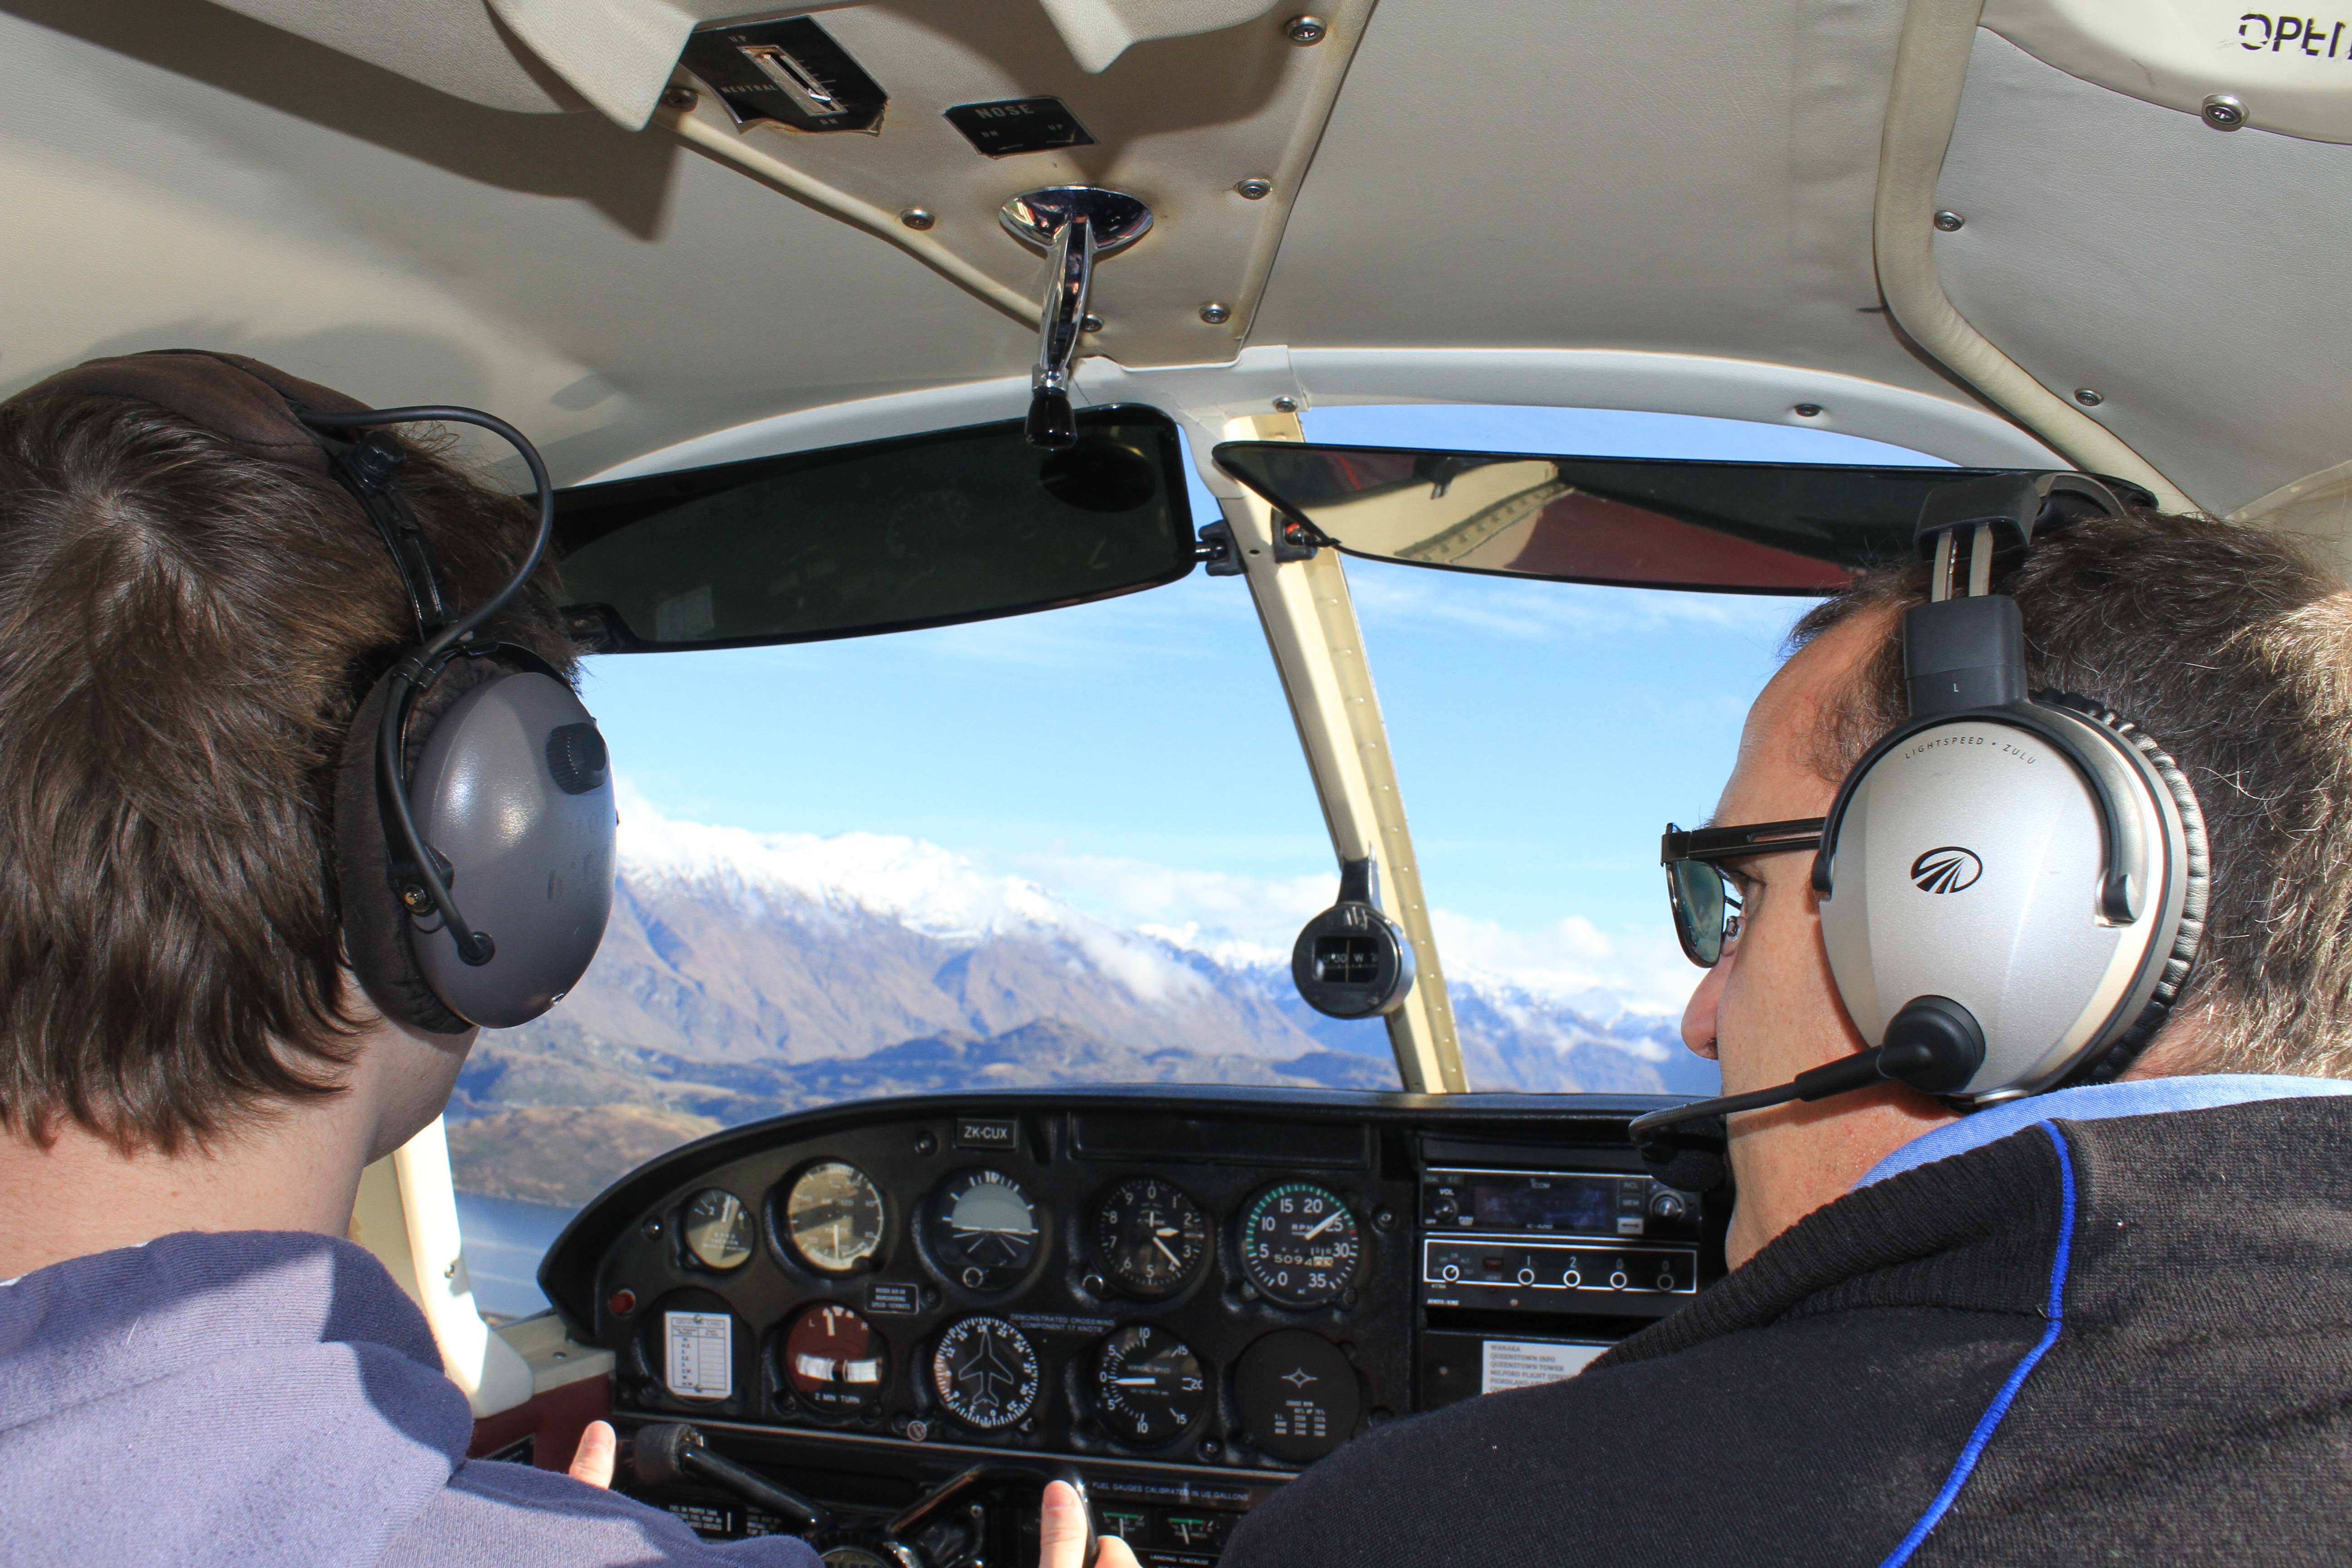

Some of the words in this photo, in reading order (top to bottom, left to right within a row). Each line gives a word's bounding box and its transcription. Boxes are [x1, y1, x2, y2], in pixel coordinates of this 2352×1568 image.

[721, 84, 779, 93] NEUTRAL
[975, 104, 1035, 119] NOSE
[1047, 123, 1063, 131] UP
[1953, 683, 1959, 692] L
[1906, 736, 1984, 759] LIGHTSPEED
[2002, 744, 2037, 764] ZULU
[964, 1125, 1008, 1140] ZK-CUX
[1125, 1191, 1134, 1205] 9
[1147, 1185, 1156, 1199] 0
[1439, 1187, 1455, 1196] VOL
[1172, 1195, 1177, 1209] 1
[1279, 1197, 1294, 1213] 15
[1303, 1197, 1323, 1213] 20
[1109, 1210, 1118, 1225] 8
[1184, 1212, 1192, 1225] 2
[1261, 1216, 1276, 1231] 10
[1110, 1235, 1118, 1249] 7
[1182, 1244, 1191, 1259] 3
[1259, 1242, 1269, 1258] 5
[1332, 1242, 1350, 1258] 30
[1123, 1256, 1132, 1269] 6
[1526, 1254, 1531, 1267] 1
[1569, 1255, 1578, 1269] 2
[1615, 1258, 1624, 1270] 0
[1661, 1259, 1670, 1272] 0
[1146, 1264, 1155, 1278] 5
[1277, 1271, 1288, 1286] 0
[1308, 1272, 1327, 1288] 35
[808, 1318, 815, 1327] L
[861, 1321, 870, 1331] R
[1010, 1313, 1068, 1324] DEMONSTRATED
[1070, 1317, 1115, 1326] CROSSWIND
[1021, 1321, 1065, 1330] COMPONENT
[1139, 1326, 1151, 1339] 10
[1107, 1343, 1116, 1356] 5
[1178, 1344, 1189, 1355] 15
[1490, 1352, 1538, 1361] QUEENSTOWN
[1490, 1362, 1538, 1370] QUEENSTOWN
[1099, 1370, 1107, 1382] 0
[840, 1394, 861, 1404] TURN
[1107, 1398, 1116, 1410] 5
[1176, 1412, 1187, 1424] 15
[1137, 1421, 1149, 1434] 10
[1092, 1481, 1110, 1490] FUEL
[1112, 1483, 1143, 1493] GAUGES
